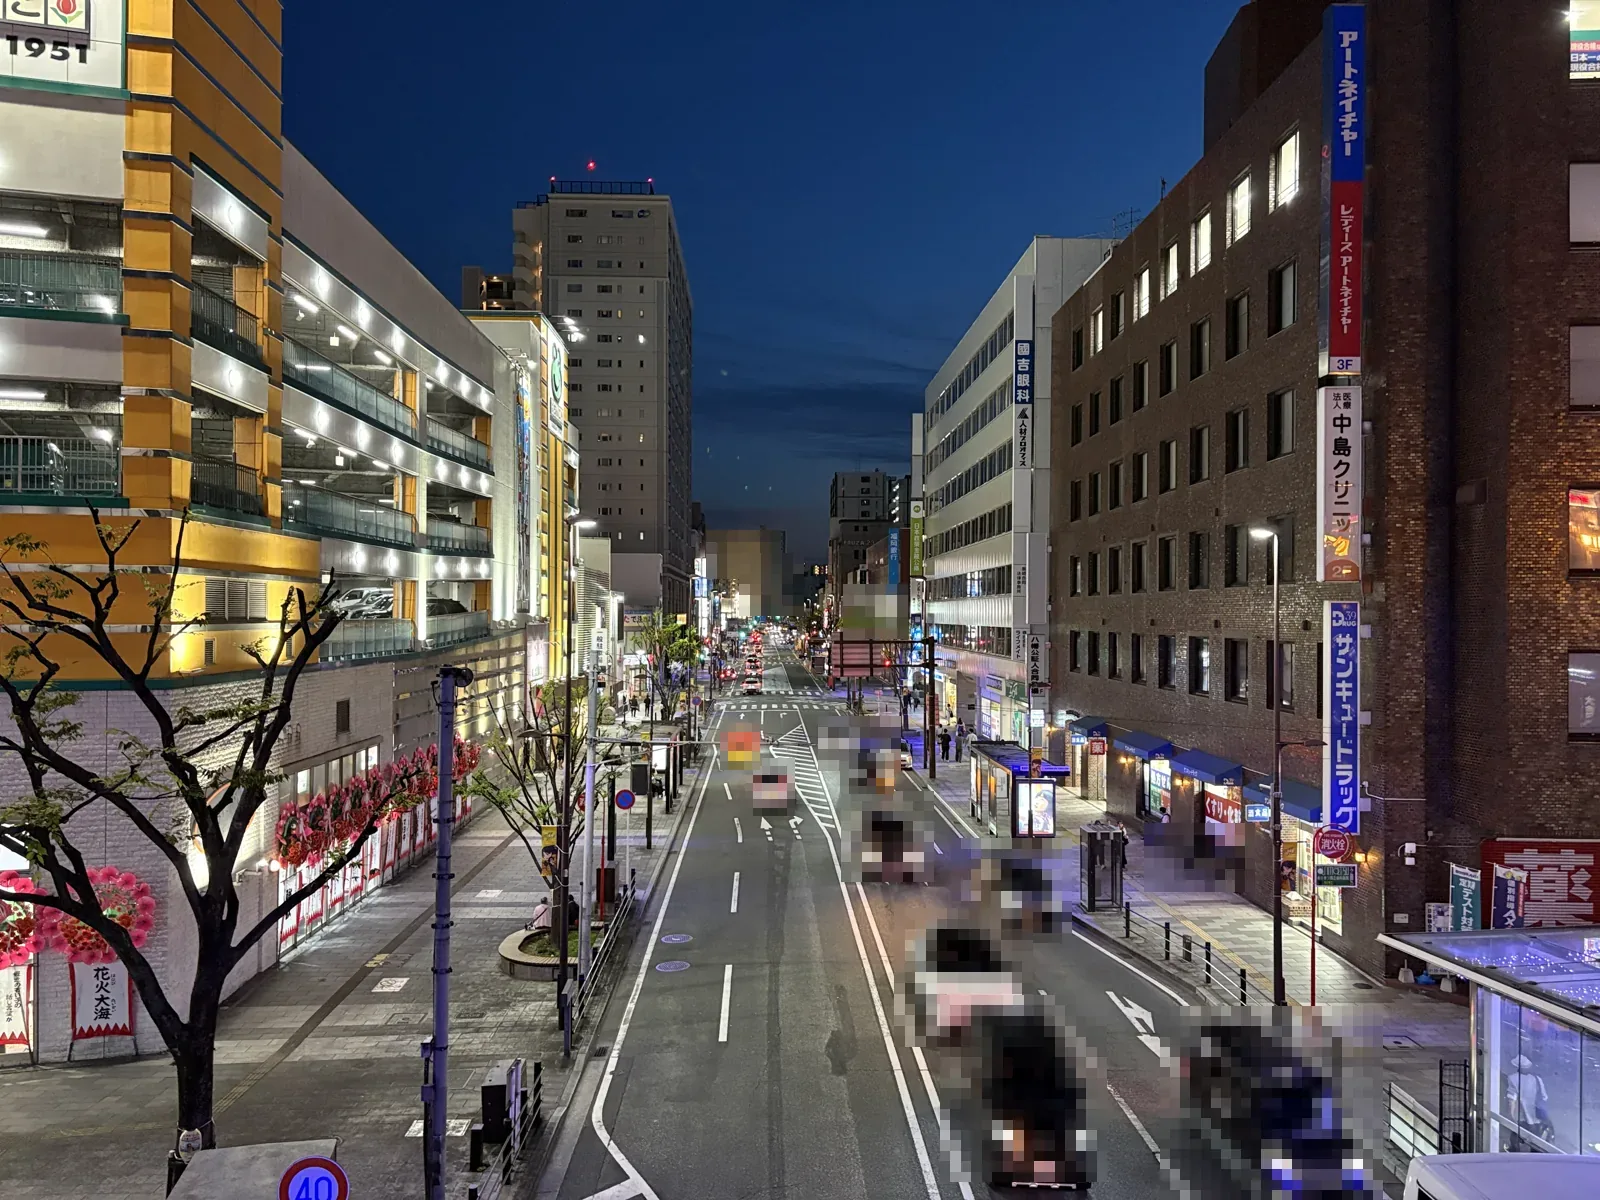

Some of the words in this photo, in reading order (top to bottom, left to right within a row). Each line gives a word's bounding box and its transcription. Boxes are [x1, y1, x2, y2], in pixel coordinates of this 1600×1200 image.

[5, 35, 88, 64] 1951
[1338, 30, 1358, 157] アートネイチャー
[1337, 359, 1354, 371] 3F
[1332, 413, 1352, 557] 中島クリニック
[1334, 633, 1357, 830] サンキュードラッグ
[1321, 838, 1346, 851] 消火栓
[93, 966, 112, 1021] 花火大海
[294, 1176, 333, 1200] 40
